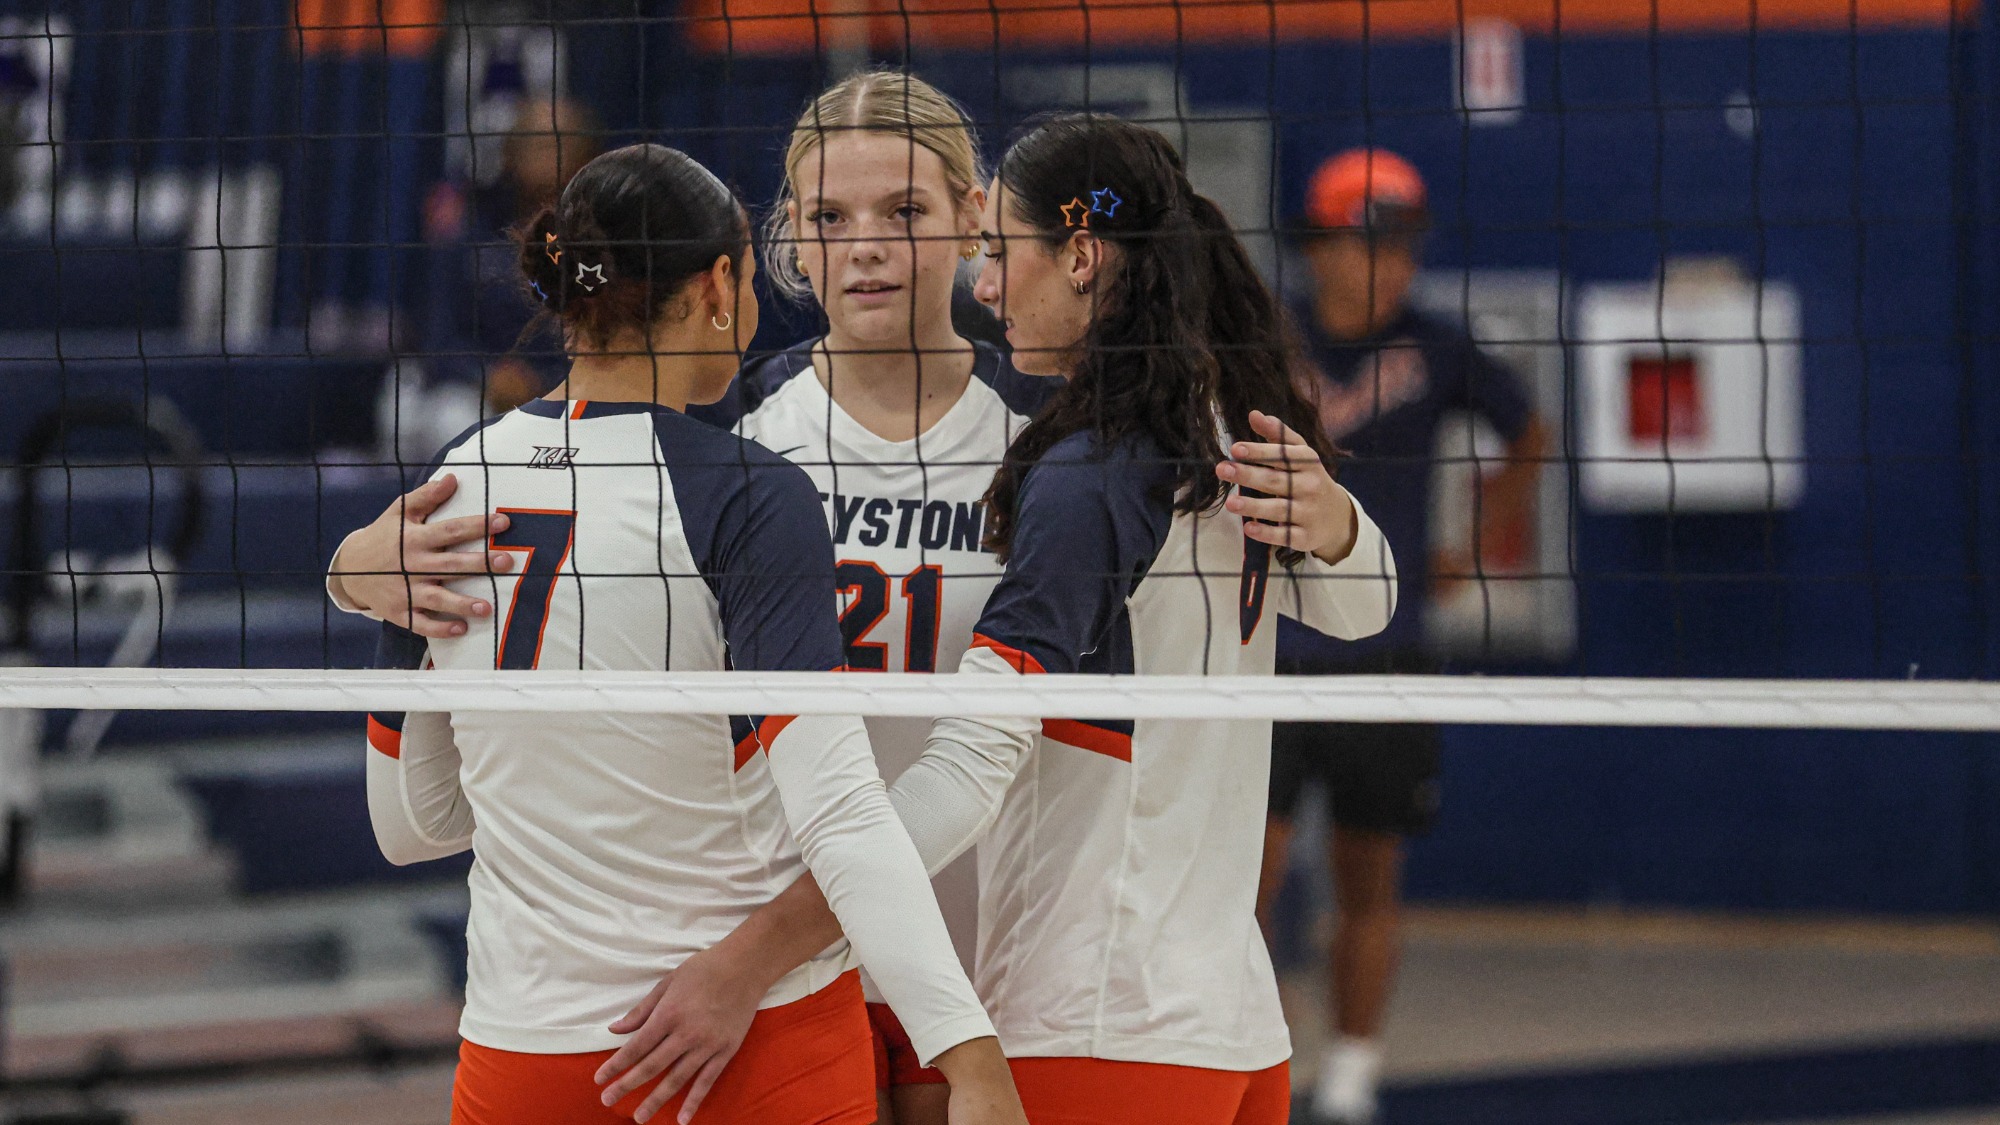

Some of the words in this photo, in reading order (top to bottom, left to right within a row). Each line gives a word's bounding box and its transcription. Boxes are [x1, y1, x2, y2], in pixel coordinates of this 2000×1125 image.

[819, 491, 996, 553] YSTON
[489, 507, 577, 670] 7
[835, 559, 942, 672] 21
